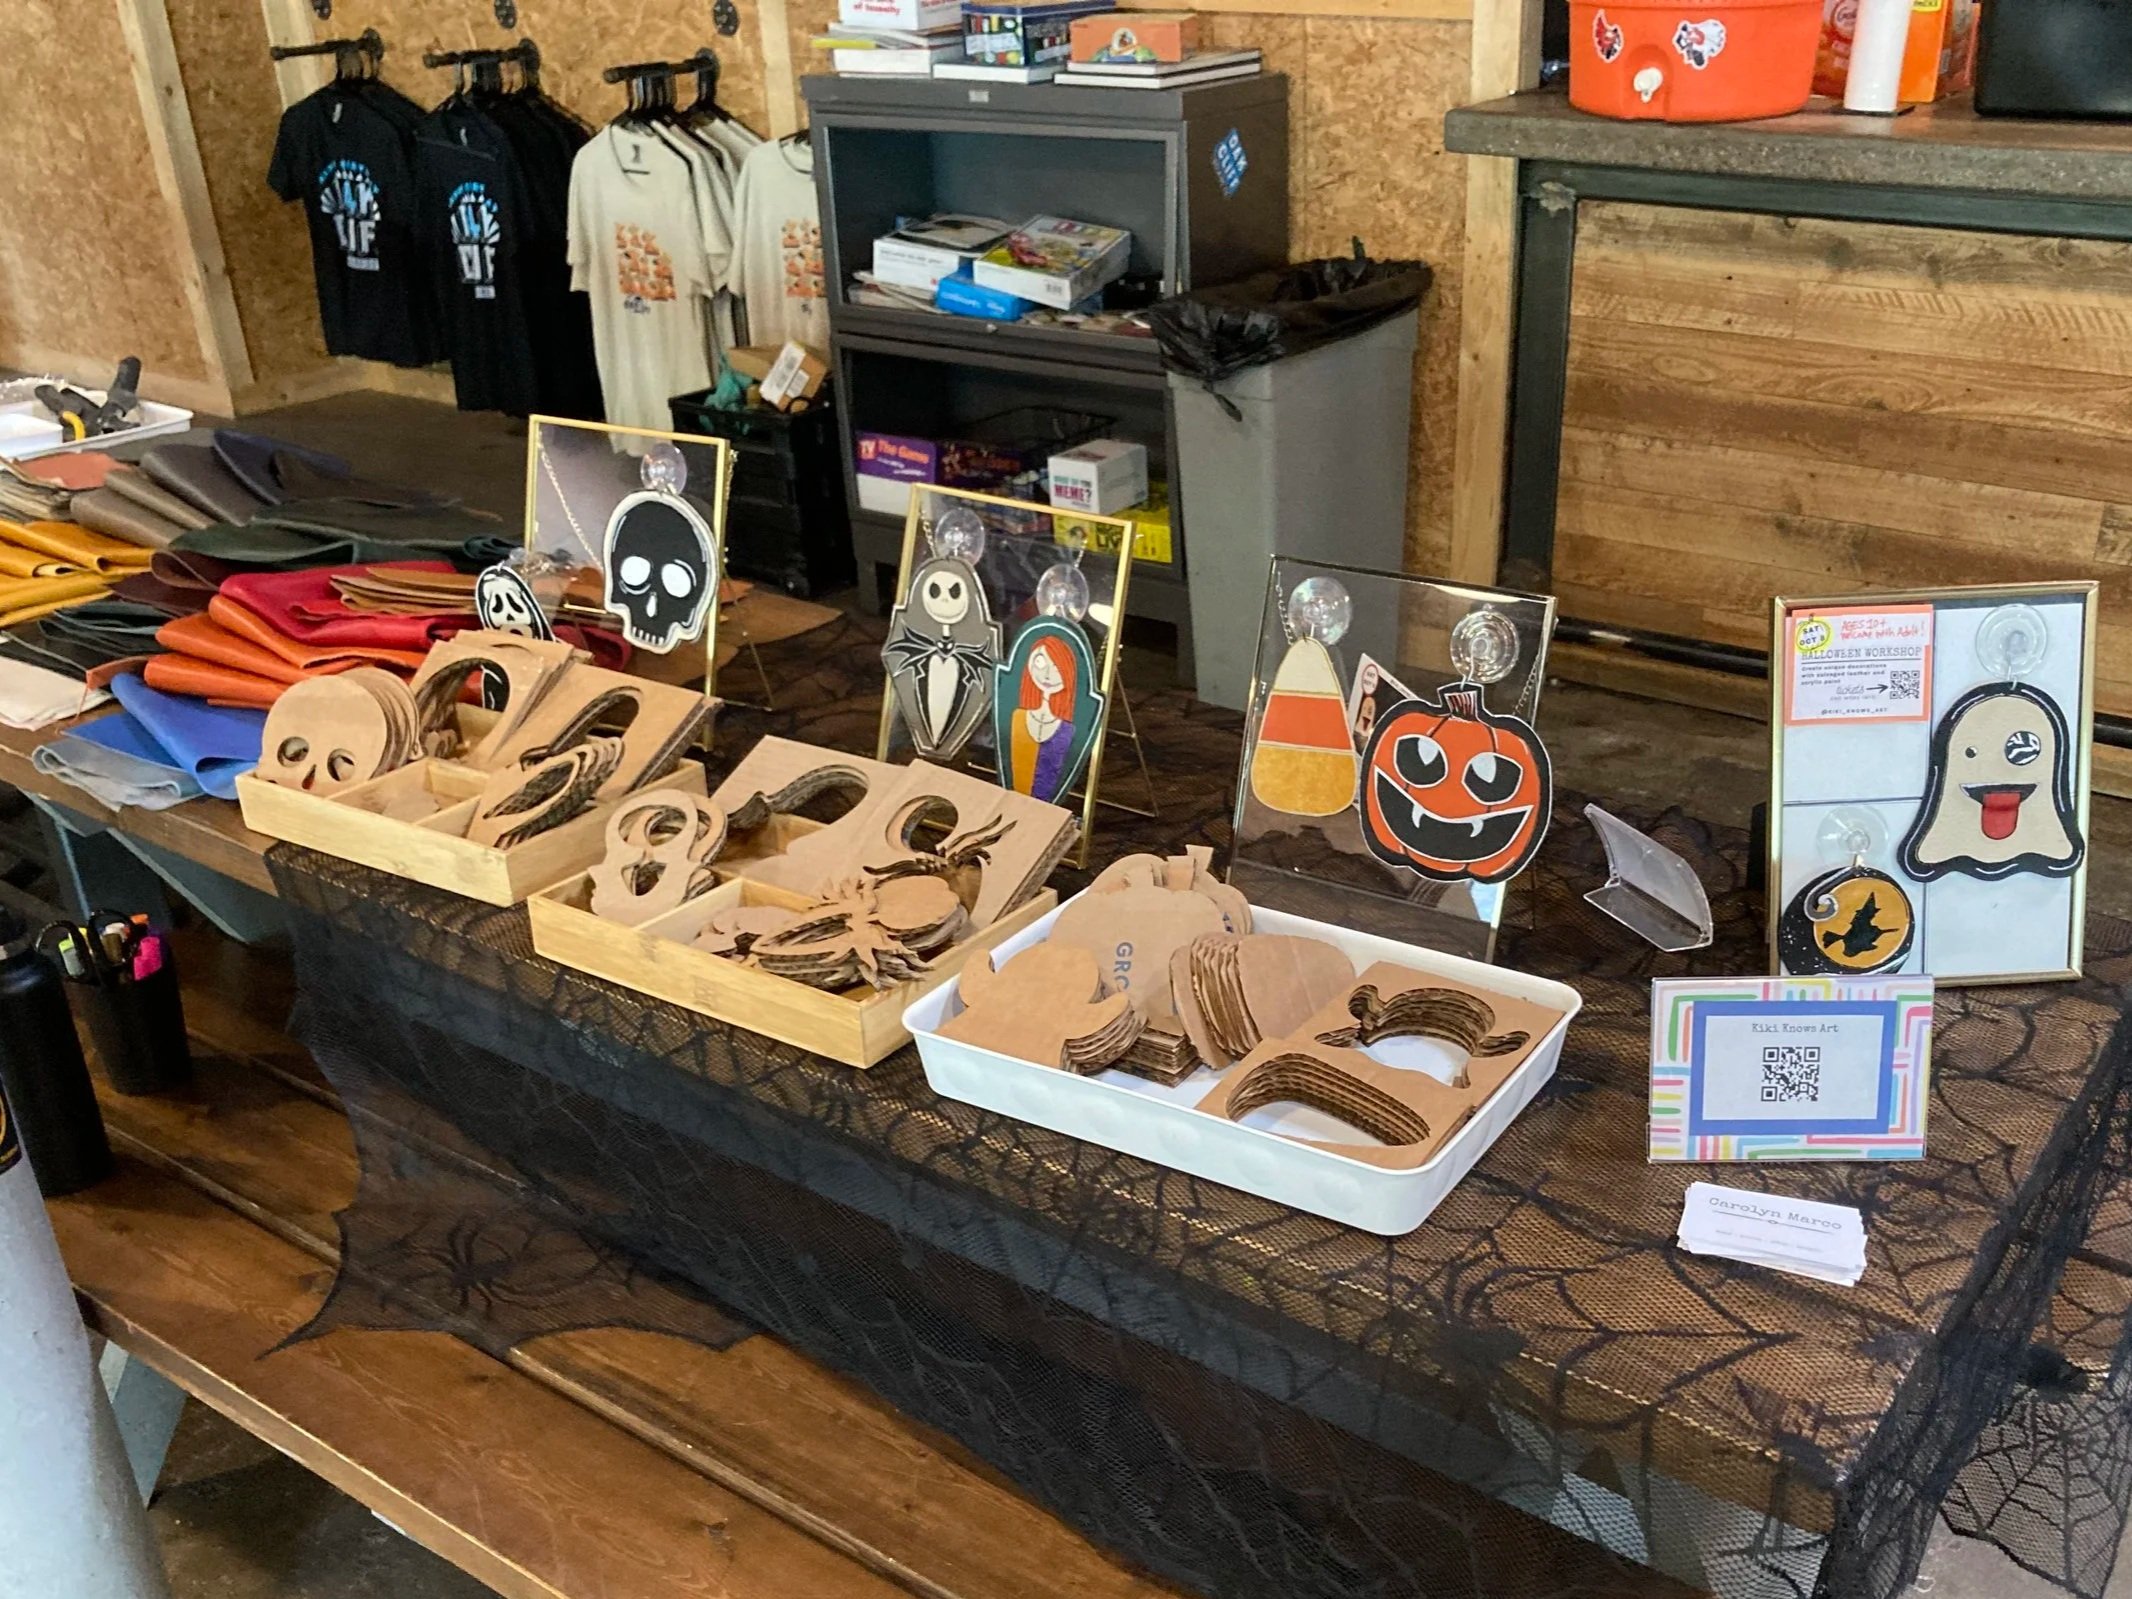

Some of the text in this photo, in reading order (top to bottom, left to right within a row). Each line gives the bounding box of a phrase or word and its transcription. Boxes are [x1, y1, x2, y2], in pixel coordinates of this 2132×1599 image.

[1054, 484, 1092, 503] MEME?
[1867, 618, 1887, 629] 10+
[1803, 625, 1819, 635] SAT
[1799, 637, 1816, 646] OCT
[1801, 646, 1922, 661] HALLOWEEN WORKSHOP
[1751, 1023, 1840, 1033] Kiki Knows Art
[1709, 1197, 1843, 1230] Carolyn Marco
